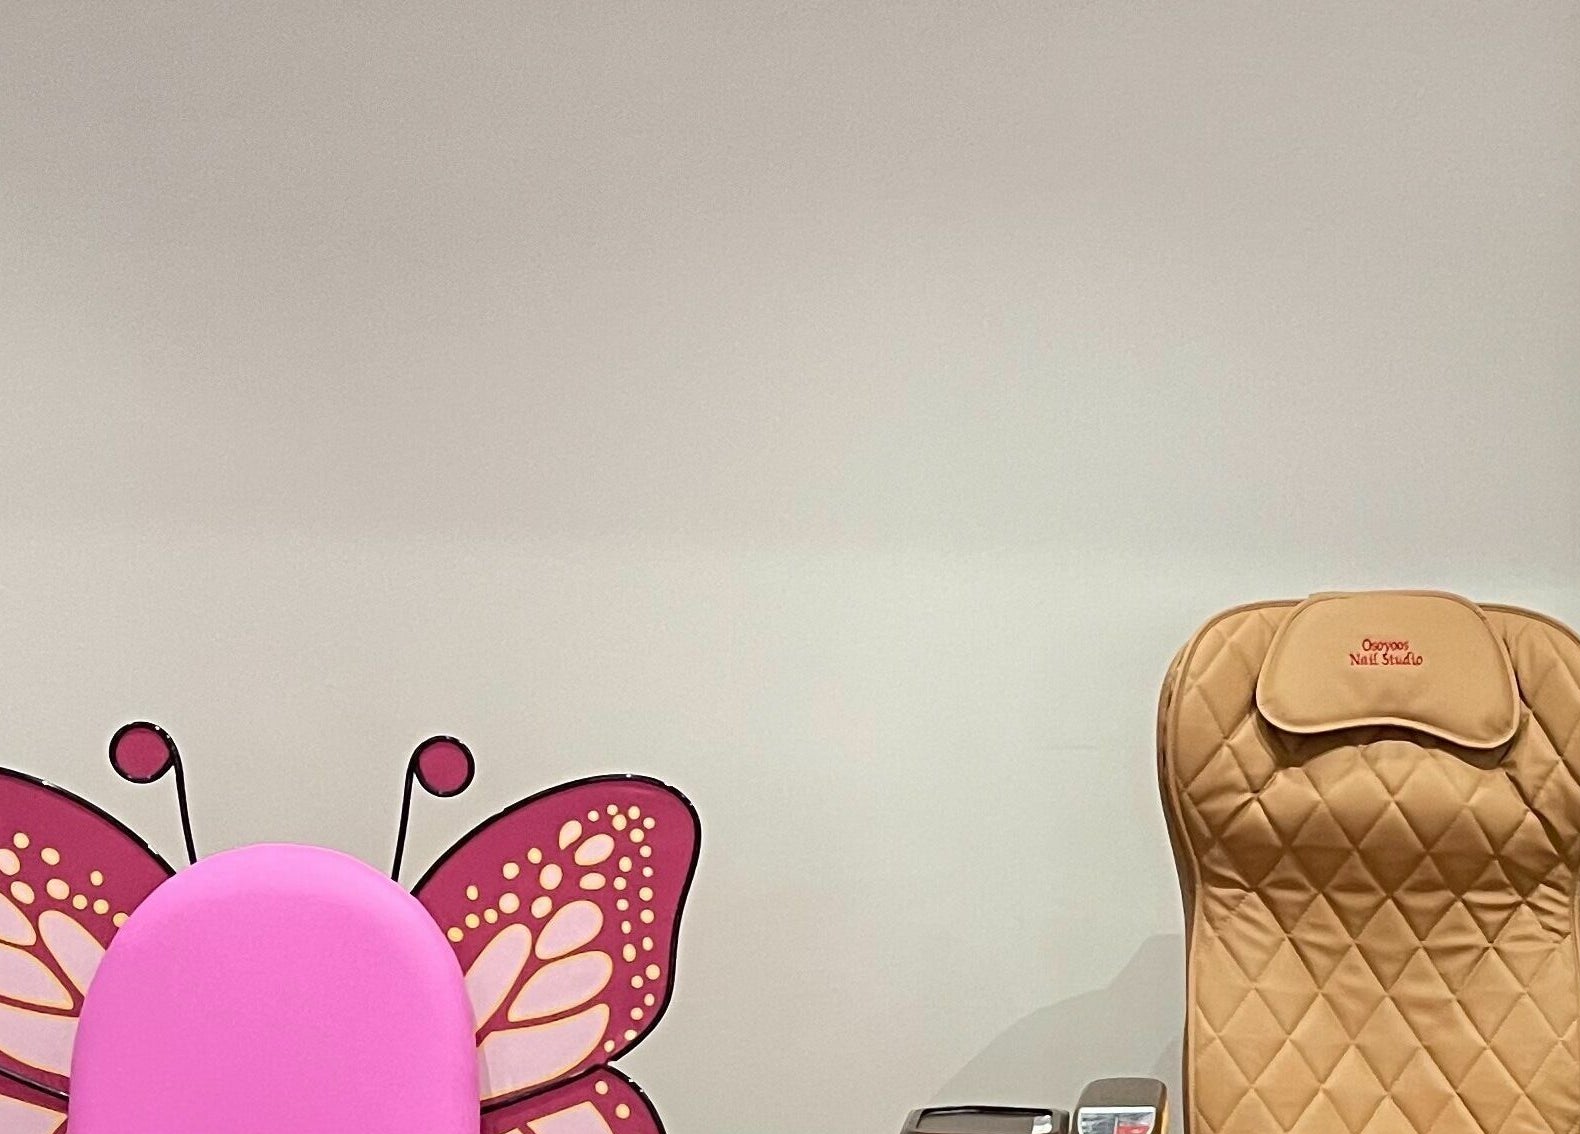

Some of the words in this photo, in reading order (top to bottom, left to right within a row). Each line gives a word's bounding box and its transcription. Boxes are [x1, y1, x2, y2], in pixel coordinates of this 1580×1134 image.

[1362, 638, 1409, 654] Osoyoos
[1349, 653, 1379, 666] Nail
[1381, 652, 1424, 666] Studio
